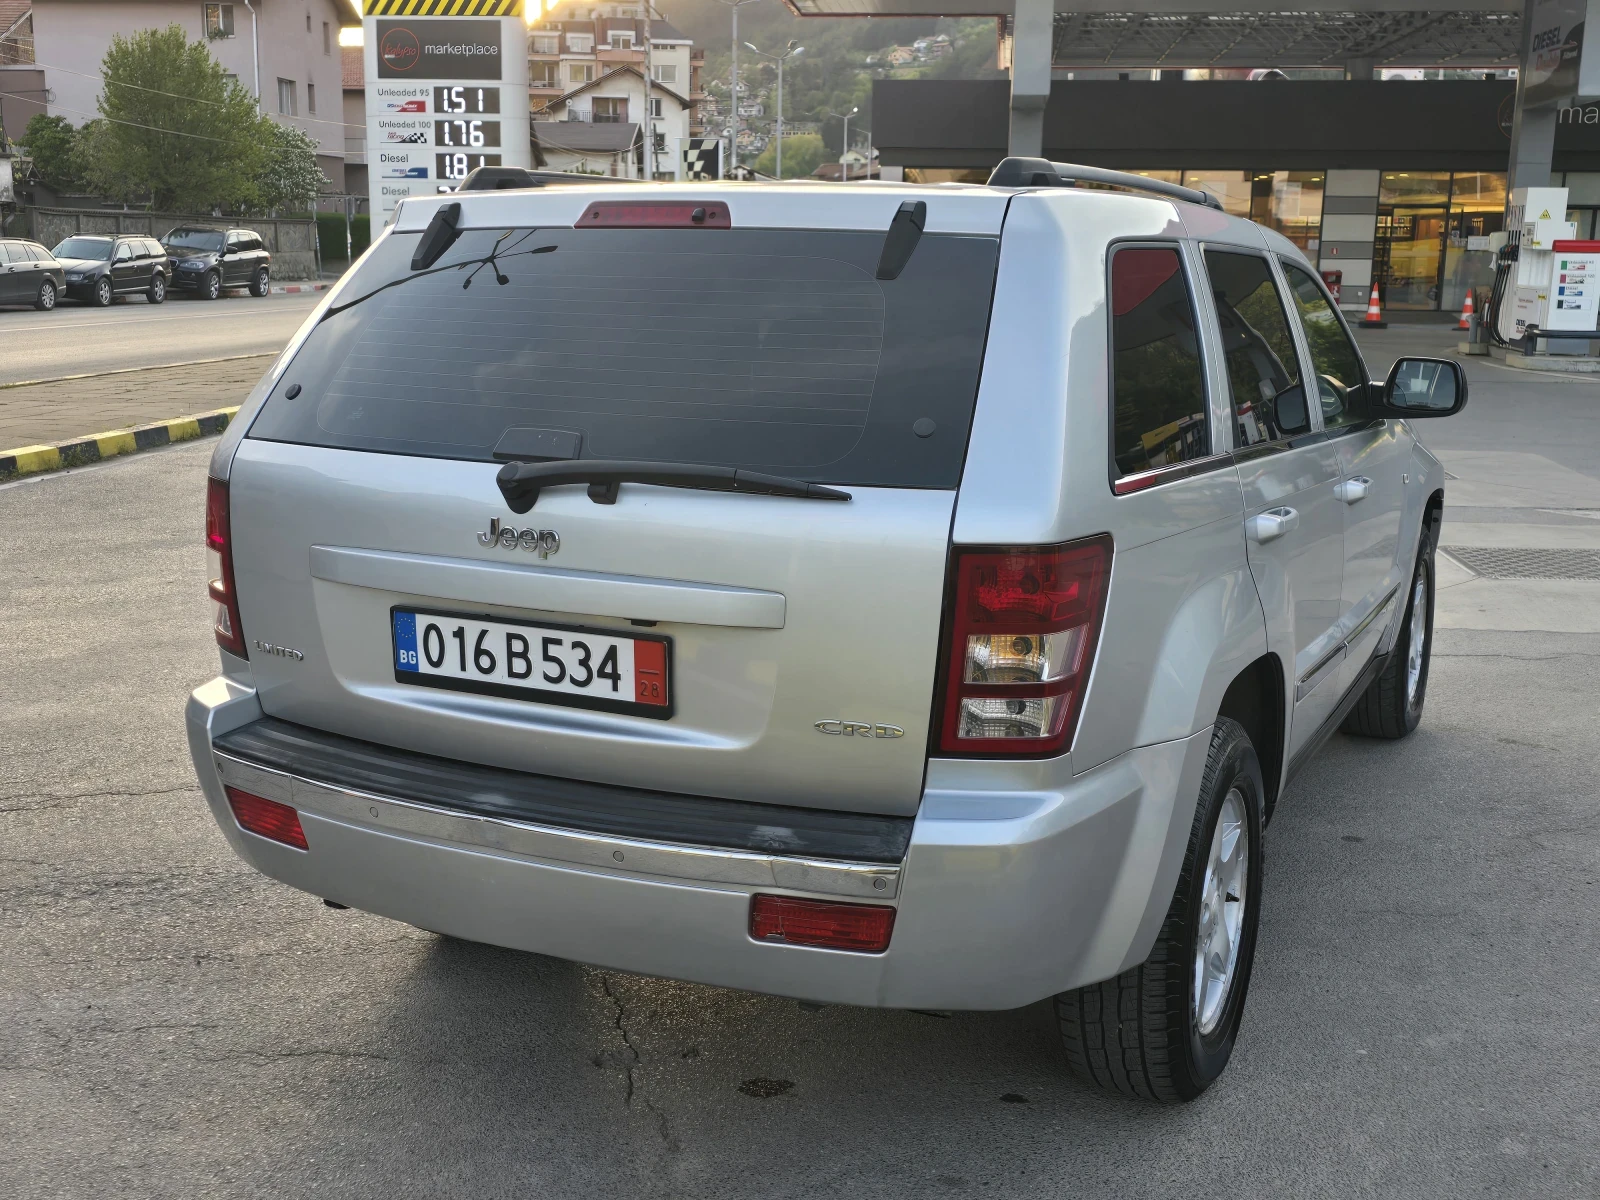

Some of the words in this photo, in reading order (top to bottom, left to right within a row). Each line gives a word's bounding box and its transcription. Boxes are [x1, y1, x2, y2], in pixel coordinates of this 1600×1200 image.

[425, 42, 498, 57] marketplace
[377, 88, 417, 97] Unleaded
[419, 88, 430, 97] 95
[378, 120, 415, 129] Unleaded
[418, 120, 431, 129] 100
[444, 120, 484, 147] 1.76
[380, 153, 409, 163] Diesel
[381, 186, 410, 196] Diesel
[476, 516, 560, 560] Jeep
[253, 639, 304, 661] LIMITED
[399, 649, 417, 664] BG
[640, 679, 660, 698] 28
[814, 718, 904, 738] CRD
